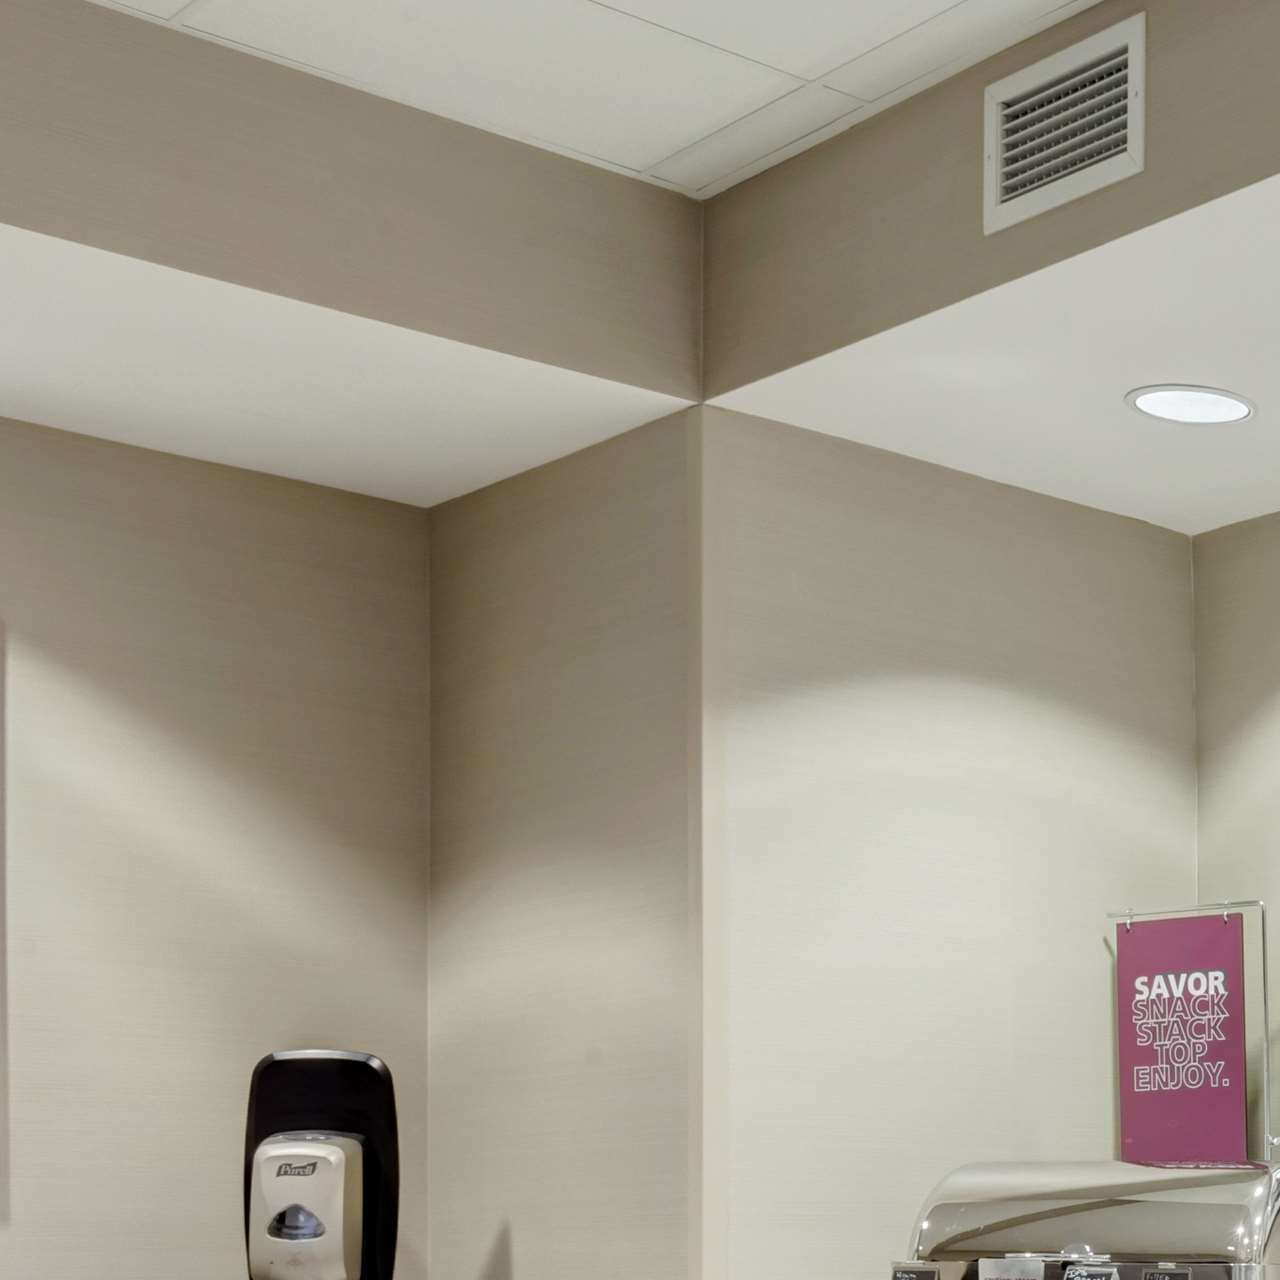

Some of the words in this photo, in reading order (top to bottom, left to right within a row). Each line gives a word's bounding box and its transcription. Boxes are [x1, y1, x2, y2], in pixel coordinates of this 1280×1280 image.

[1134, 970, 1228, 1000] SAVOR
[1132, 991, 1230, 1023] SNACK
[1136, 1016, 1227, 1046] STACK
[1154, 1040, 1208, 1068] TOP
[1133, 1062, 1230, 1092] ENJOY.
